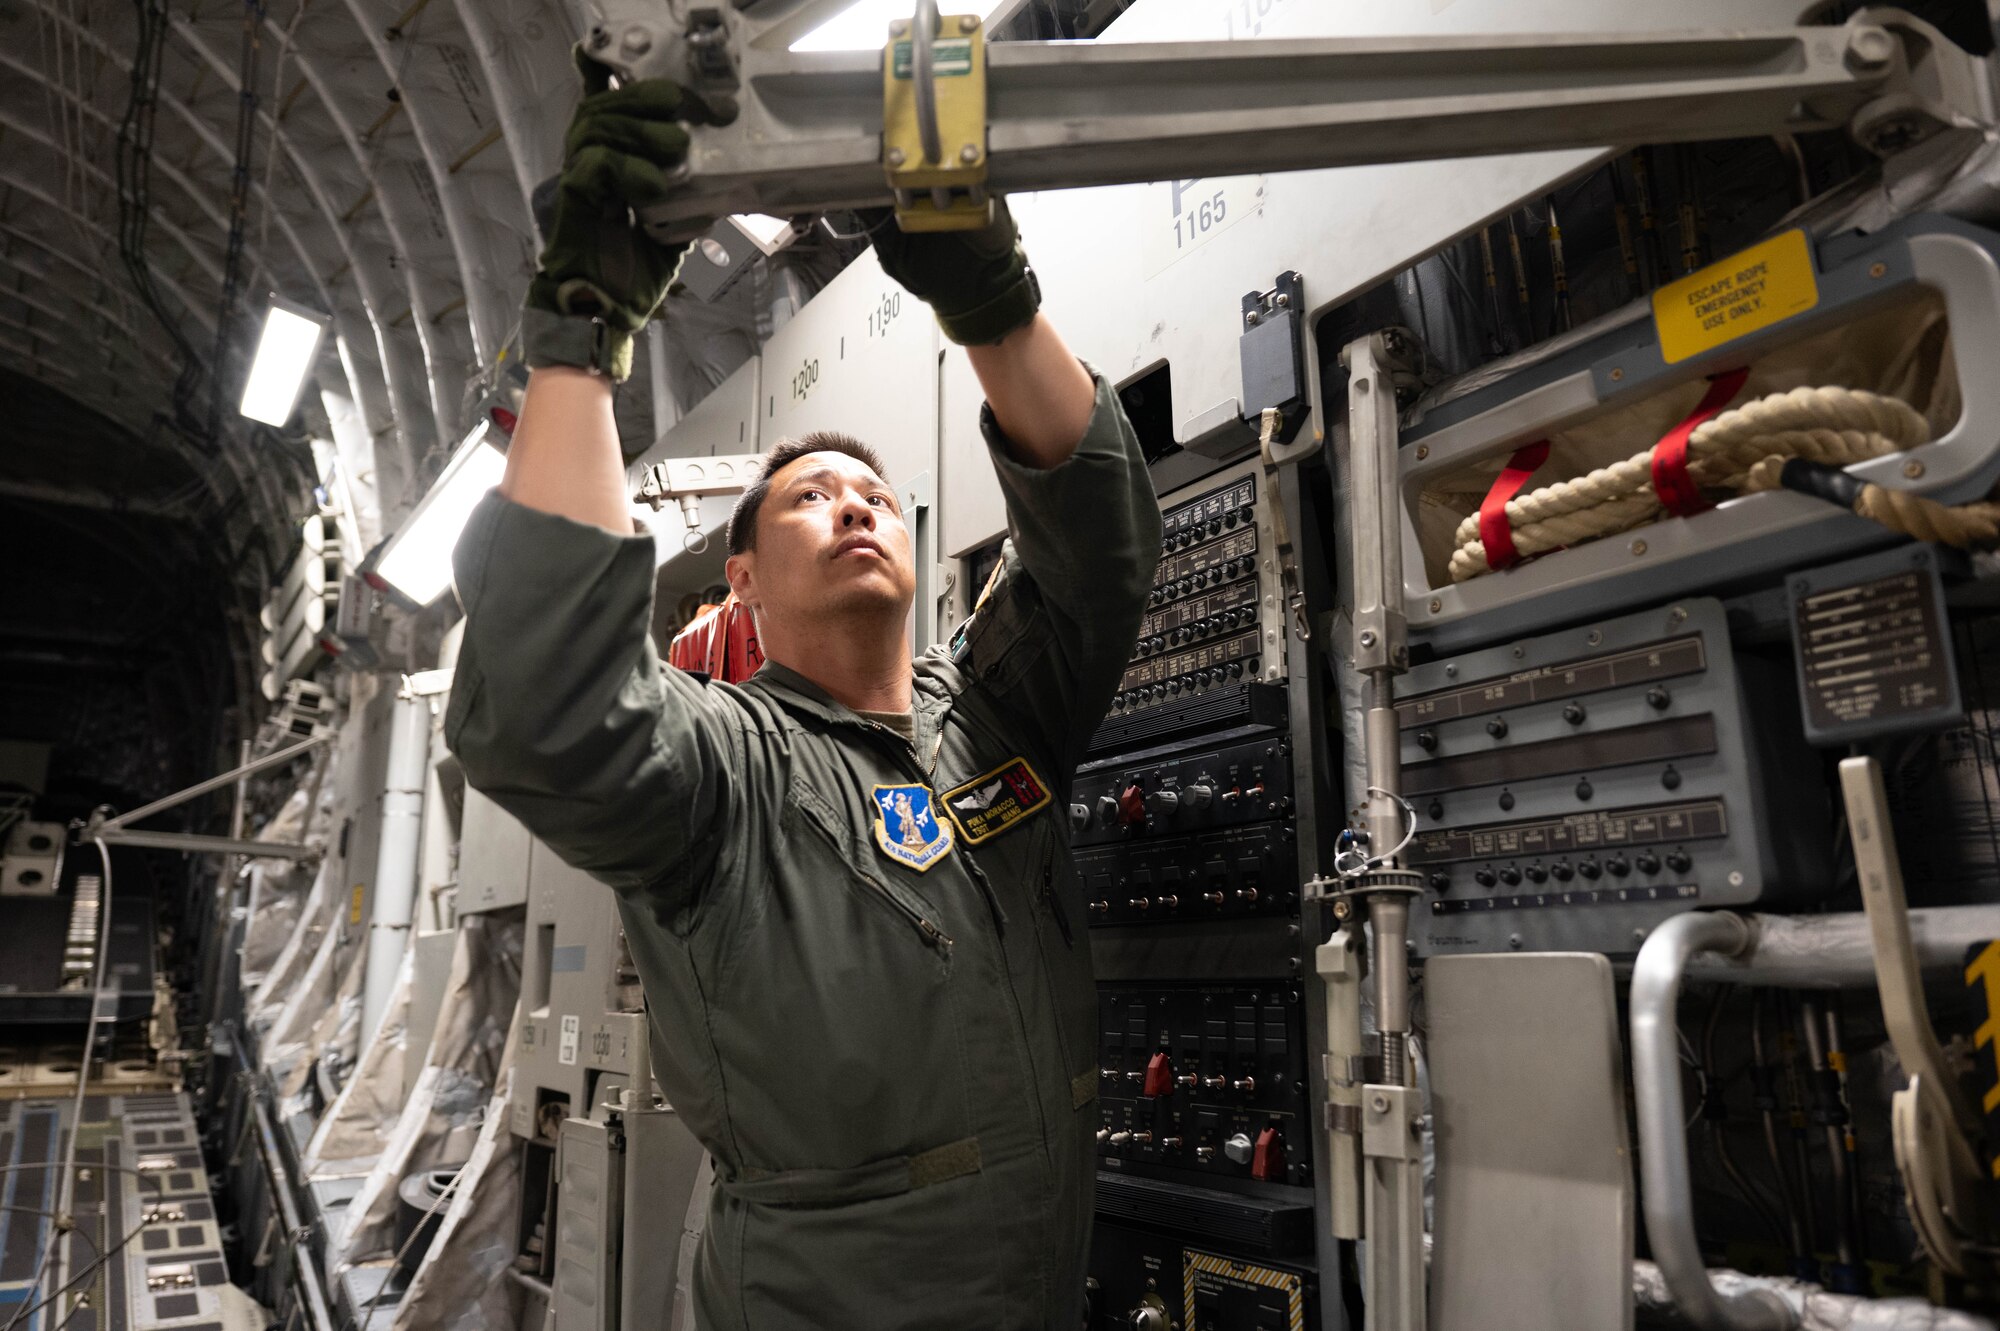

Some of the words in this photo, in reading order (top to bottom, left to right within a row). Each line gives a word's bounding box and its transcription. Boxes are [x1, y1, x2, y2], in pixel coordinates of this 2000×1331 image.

[1174, 190, 1226, 249] 1165
[1687, 277, 1733, 306] ESCAPE
[1736, 261, 1769, 286] ROPE
[1695, 278, 1767, 319] EMERGENCY
[868, 292, 900, 337] 1190
[1702, 313, 1726, 331] USE
[1730, 297, 1766, 320] ONLY.
[792, 359, 819, 399] 1200
[985, 798, 1016, 820] MORACCO
[972, 823, 988, 837] TSGT
